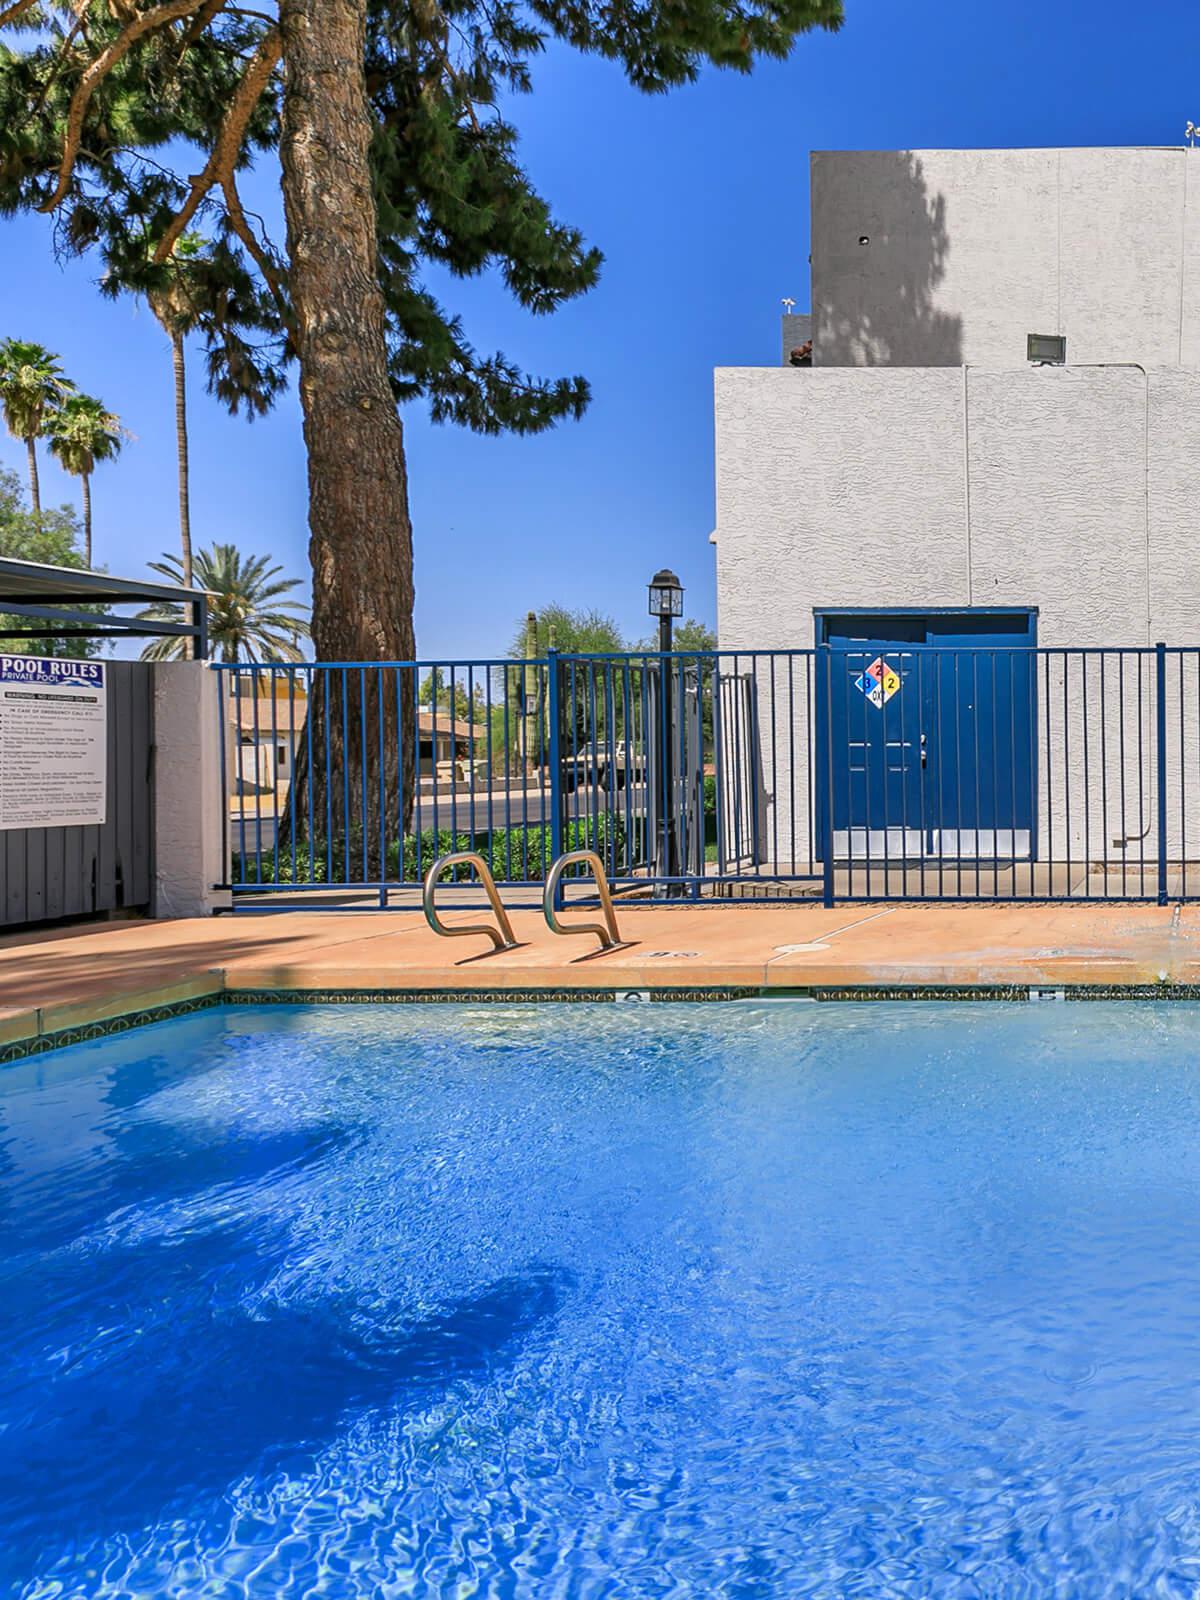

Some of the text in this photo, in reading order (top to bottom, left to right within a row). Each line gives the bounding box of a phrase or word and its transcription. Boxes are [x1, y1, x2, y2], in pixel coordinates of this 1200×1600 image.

[2, 658, 98, 678] POOL RULES
[1, 672, 59, 682] PRIVATE POOL
[888, 678, 895, 688] 2
